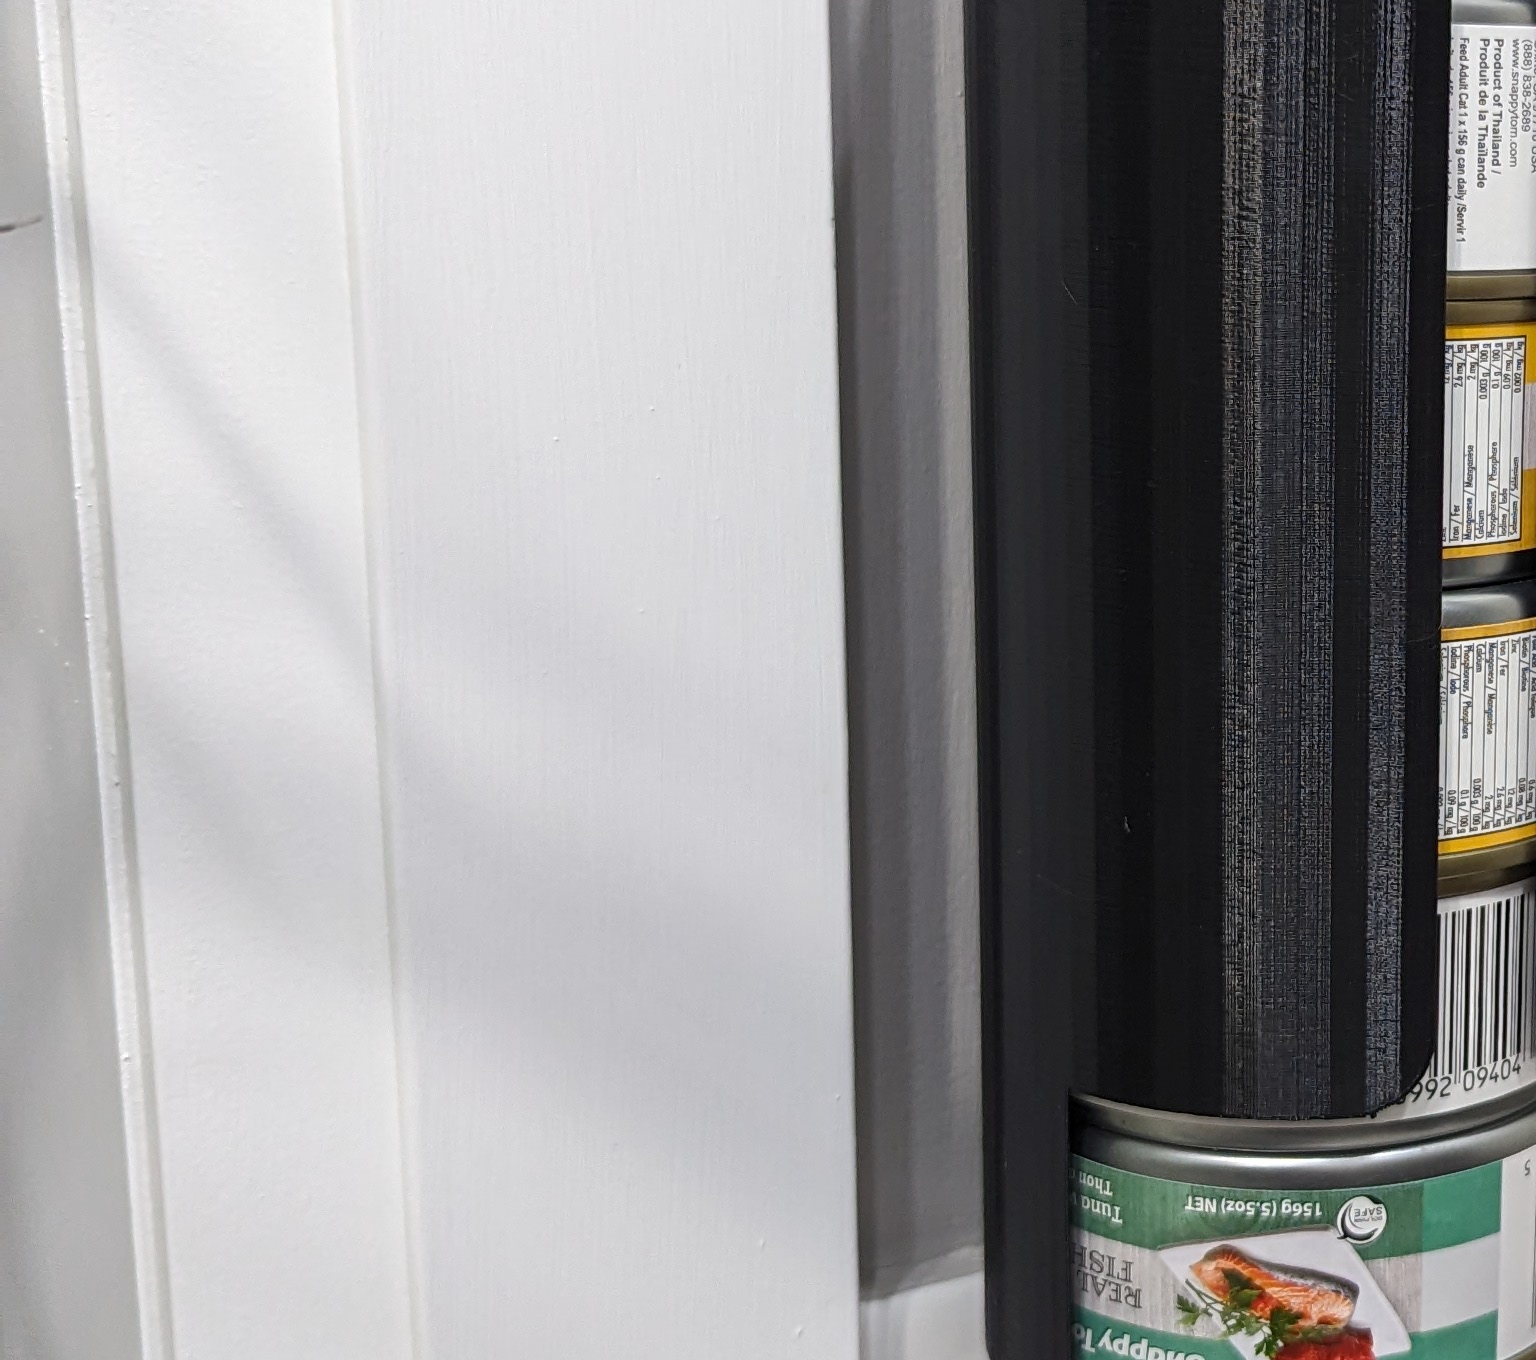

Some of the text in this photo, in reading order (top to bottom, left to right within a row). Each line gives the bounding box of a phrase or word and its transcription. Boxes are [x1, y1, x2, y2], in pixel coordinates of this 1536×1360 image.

[1460, 38, 1469, 61] Feed
[1494, 39, 1504, 90] Product
[1460, 64, 1469, 90] Adult
[1521, 40, 1533, 132] (888) 838-2689
[1459, 93, 1469, 109] Cat
[1493, 94, 1503, 108] of
[1508, 39, 1520, 167] www.snappytom.com
[1477, 39, 1490, 188] Produit de la Thaïlande
[1458, 130, 1468, 146] 156
[1492, 111, 1502, 166] Thailand
[1458, 158, 1466, 175] can
[1454, 178, 1467, 200] daily
[1480, 350, 1488, 363] 100
[1492, 350, 1500, 362] 100
[1470, 362, 1478, 373] mg
[1506, 360, 1513, 371] mg
[1517, 359, 1523, 370] mg
[1503, 374, 1511, 389] 0.09
[1450, 505, 1460, 516] Fer
[1450, 526, 1459, 541] Iron
[1500, 641, 1508, 656] Iron
[1511, 639, 1519, 654] Zinc
[1476, 644, 1485, 672] Calcium
[1500, 665, 1508, 676] Fer
[1448, 790, 1456, 805] 0.09
[1460, 790, 1469, 799] 0.1
[1460, 815, 1468, 827] 100
[1473, 813, 1481, 825] 100
[1401, 1052, 1521, 1103] 992 09404
[1079, 1171, 1112, 1196] Thon
[1081, 1195, 1122, 1224] Tuna
[1185, 1196, 1322, 1216] 156g (5.5oz) NET
[1354, 1207, 1382, 1217] SAFE
[1077, 1270, 1142, 1308] REAL
[1070, 1322, 1095, 1352] To
